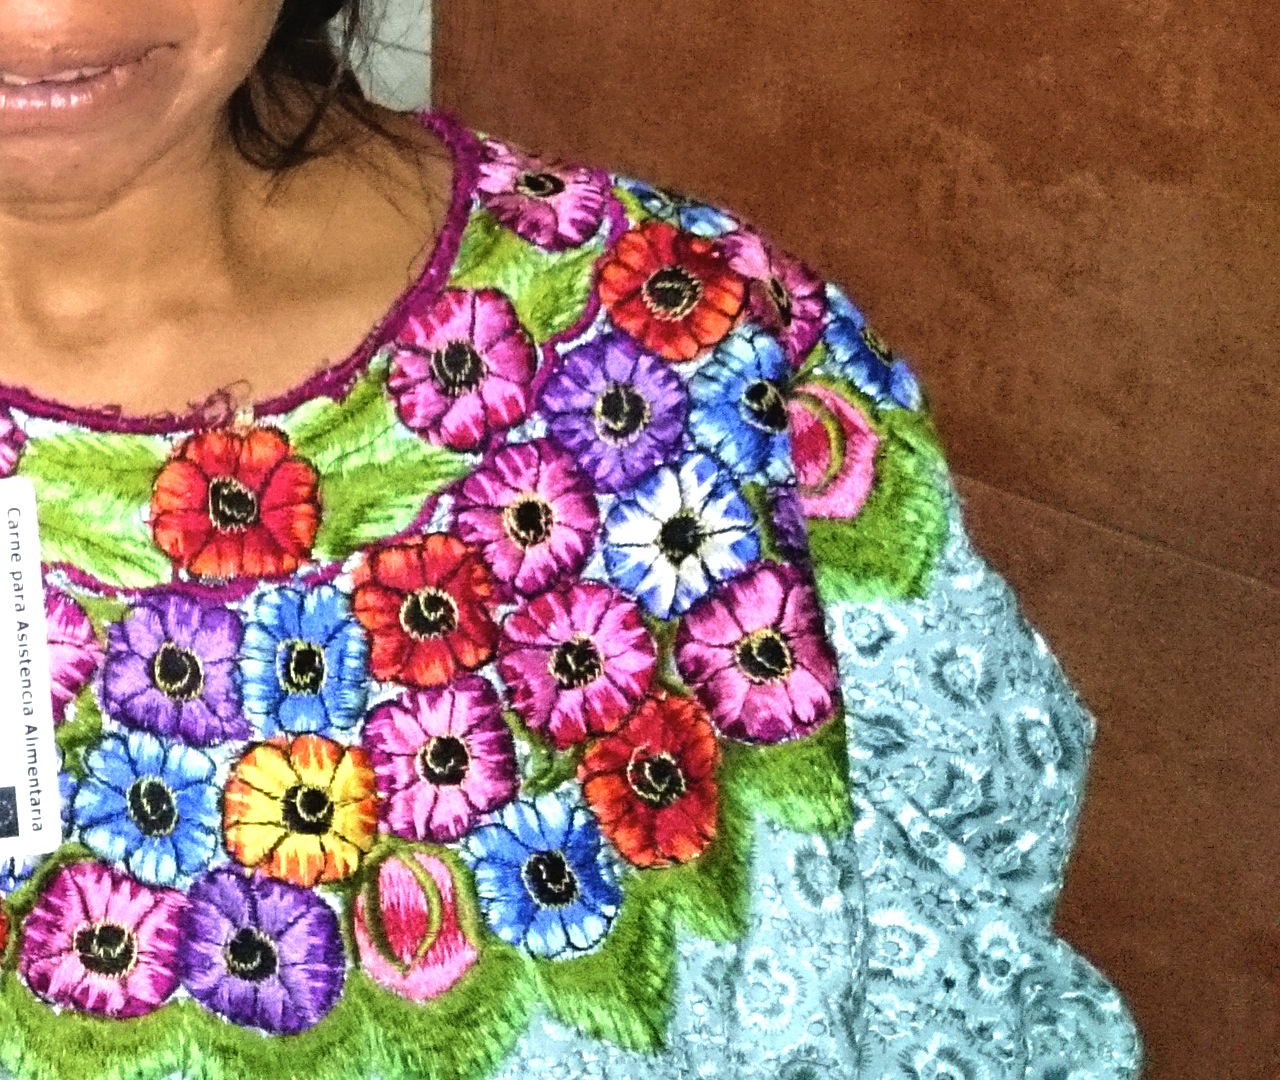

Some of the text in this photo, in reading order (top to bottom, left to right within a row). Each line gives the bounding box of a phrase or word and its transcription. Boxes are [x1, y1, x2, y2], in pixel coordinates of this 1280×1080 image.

[9, 570, 29, 613] para
[16, 620, 36, 717] Asistencia
[24, 723, 45, 833] Alimentaria
